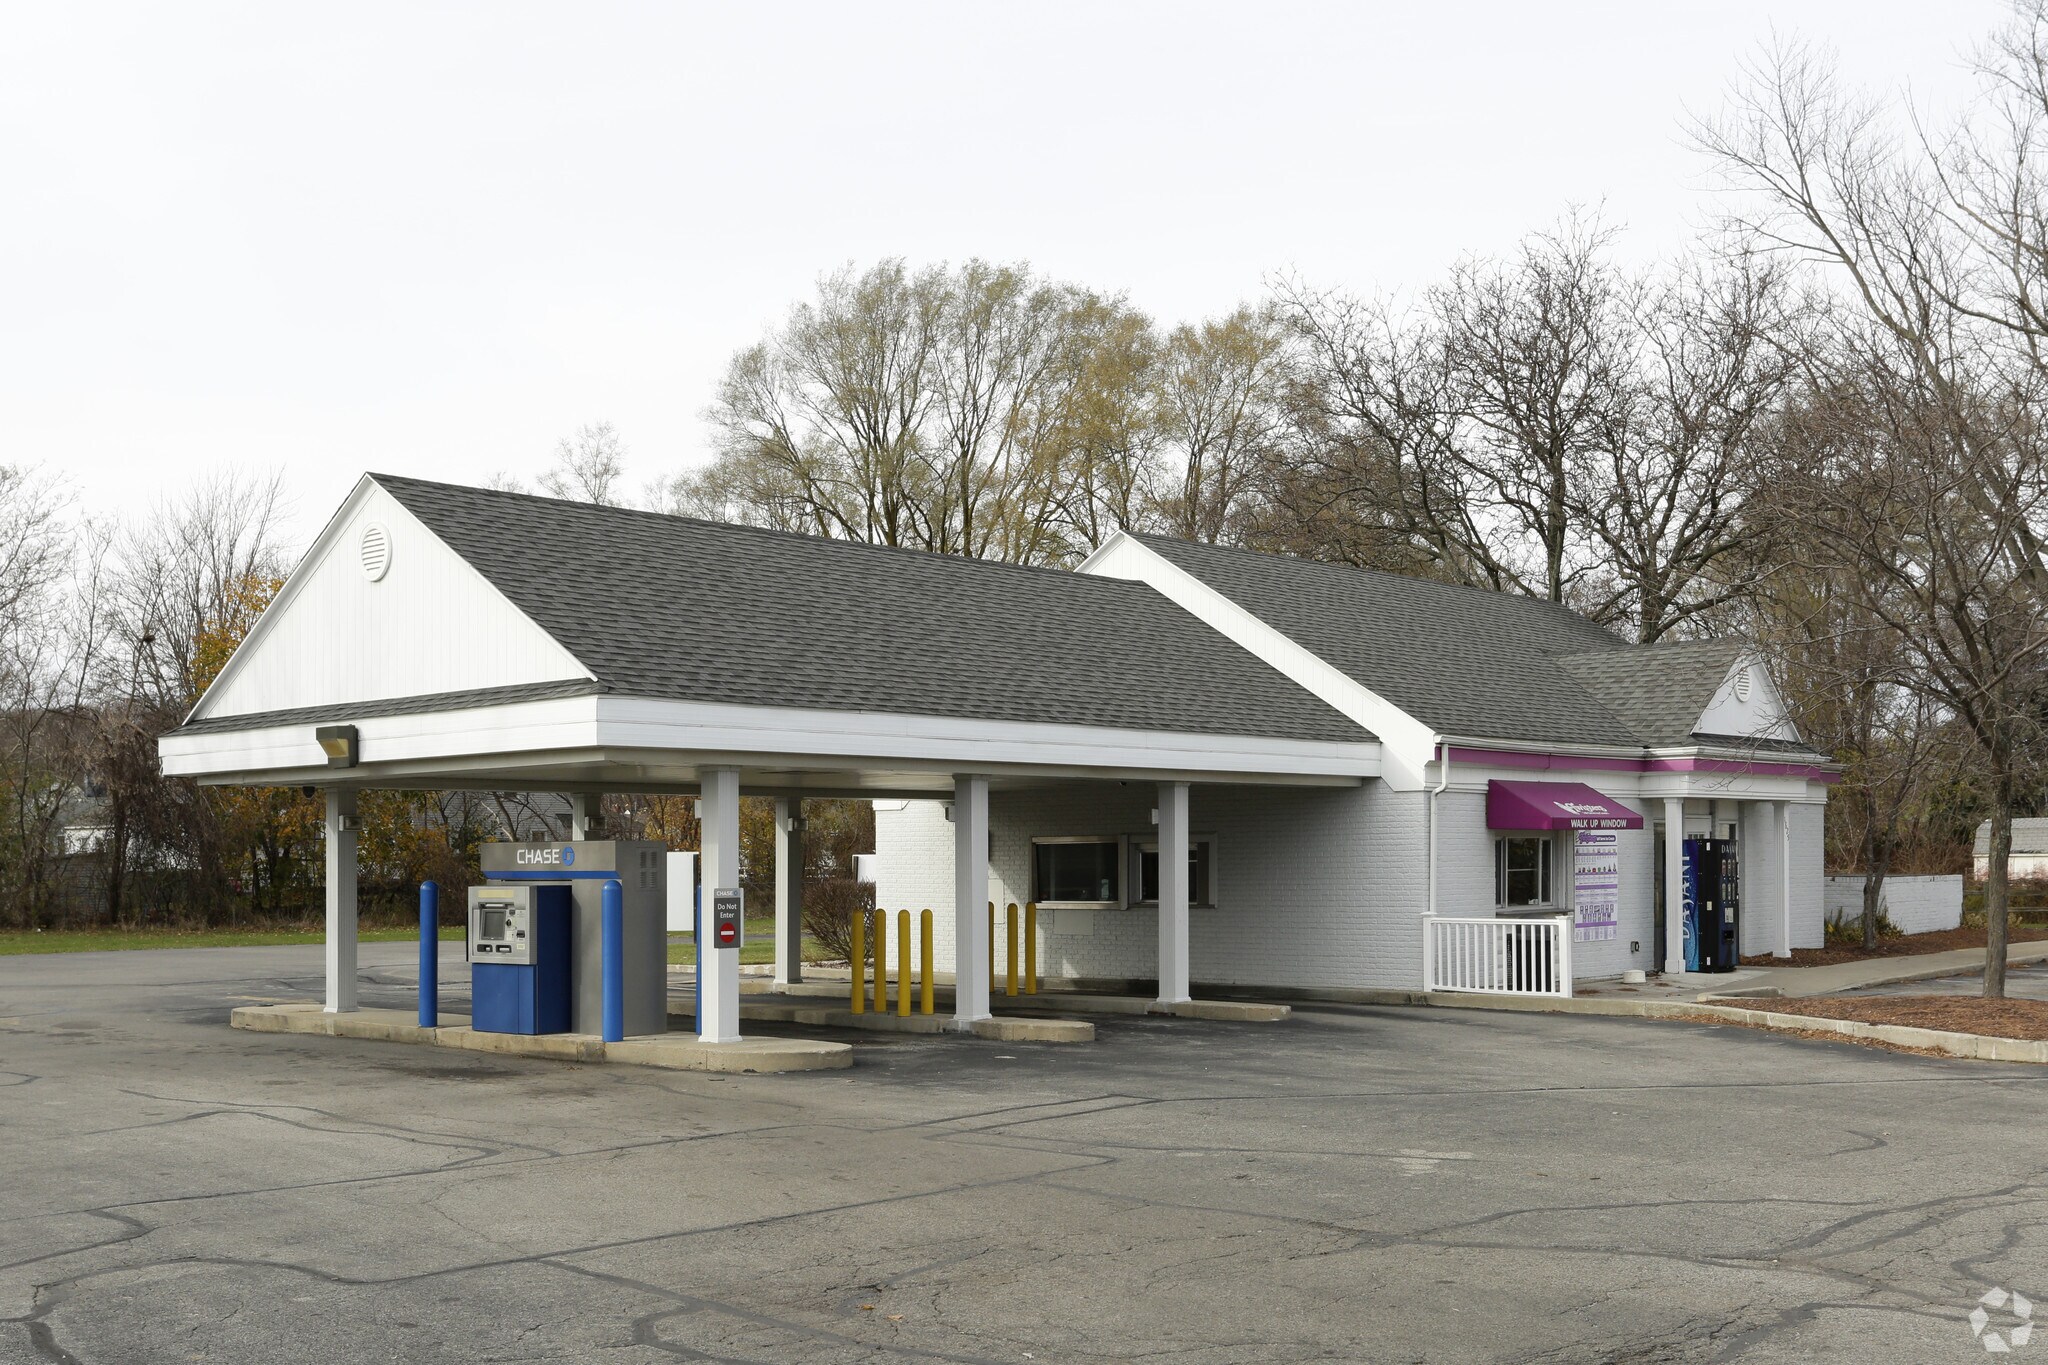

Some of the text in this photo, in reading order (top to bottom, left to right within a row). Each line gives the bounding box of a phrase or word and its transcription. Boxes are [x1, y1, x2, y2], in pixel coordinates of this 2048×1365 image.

[1570, 819, 1627, 828] WALK UP WINDOW
[516, 848, 560, 864] CHASE
